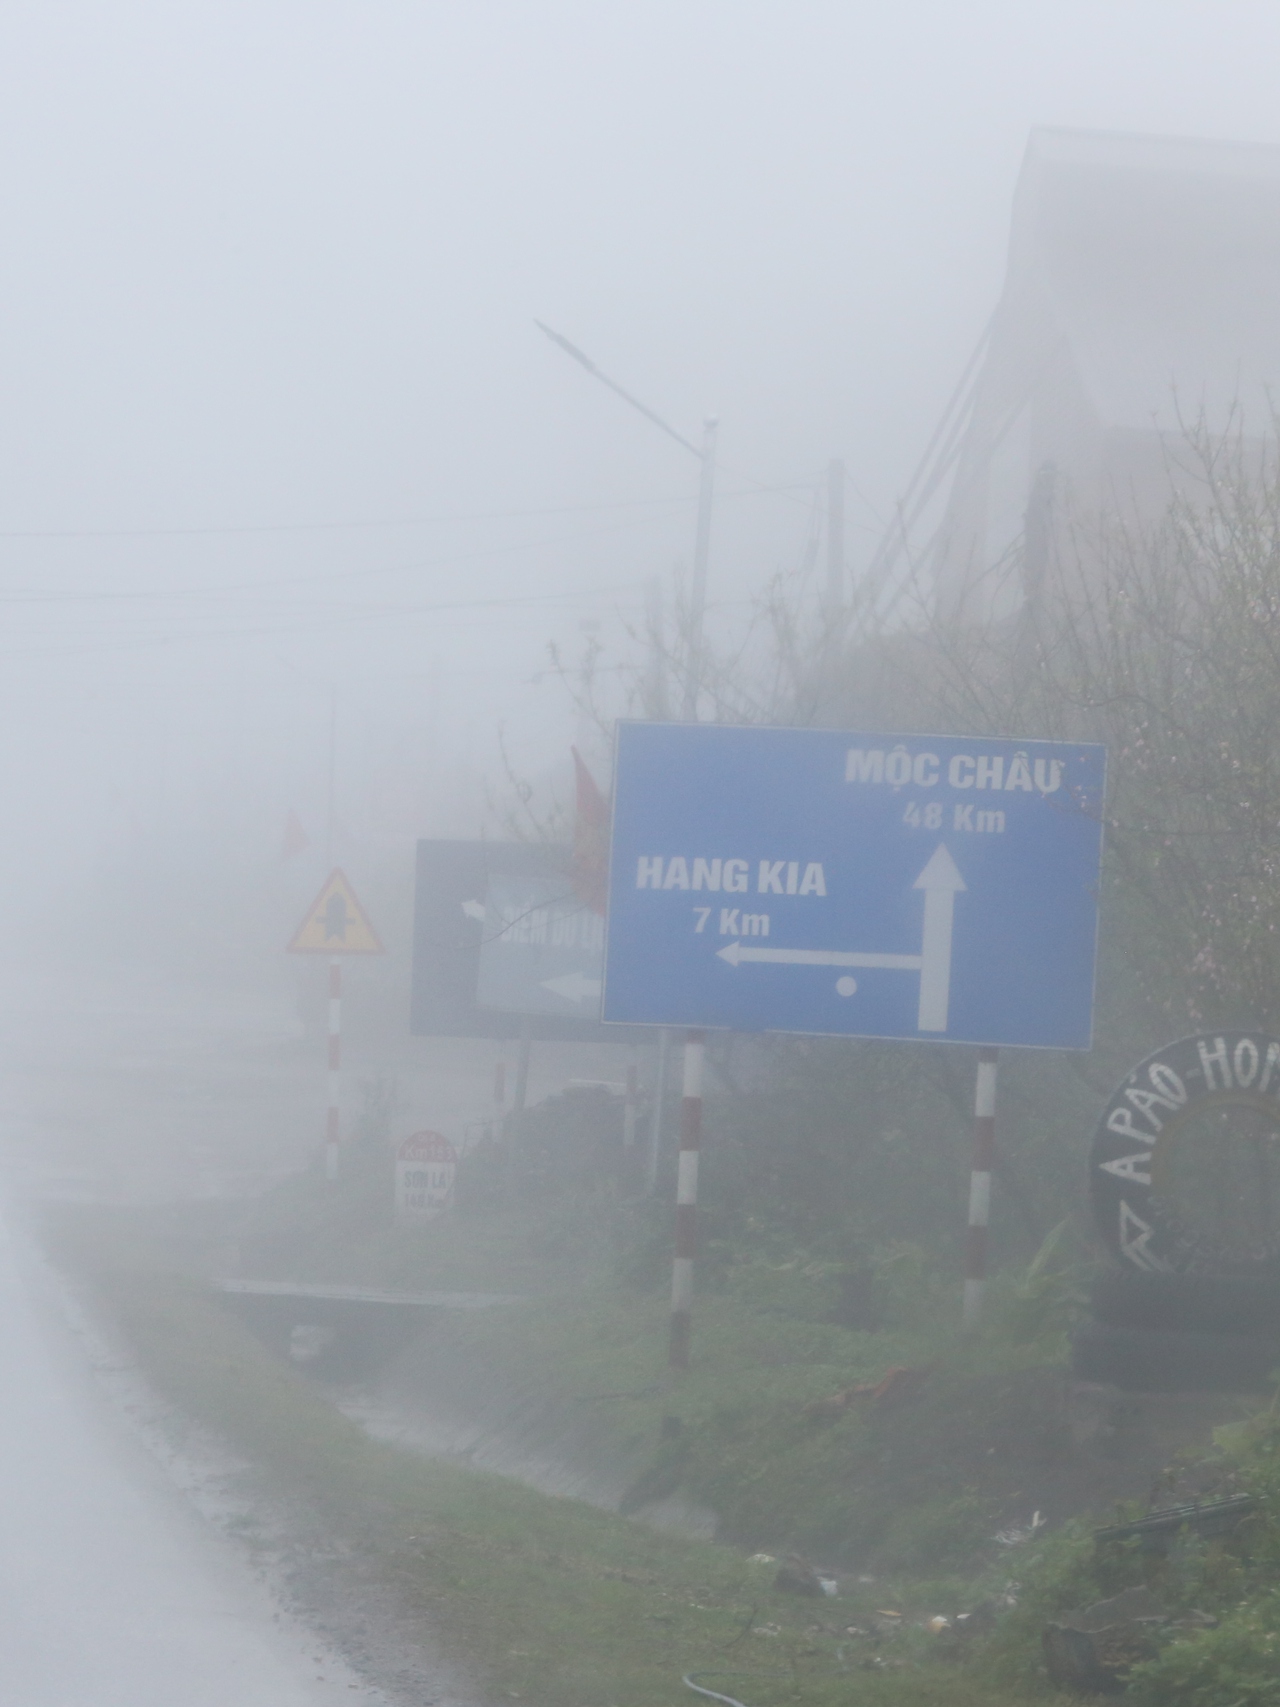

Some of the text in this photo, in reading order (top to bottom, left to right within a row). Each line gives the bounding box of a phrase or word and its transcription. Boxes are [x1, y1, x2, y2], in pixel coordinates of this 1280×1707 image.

[844, 744, 1062, 794] MỘC CHÂU
[902, 801, 1006, 833] 48 Km
[636, 855, 828, 897] HANG KIA
[692, 907, 770, 937] 7 Km
